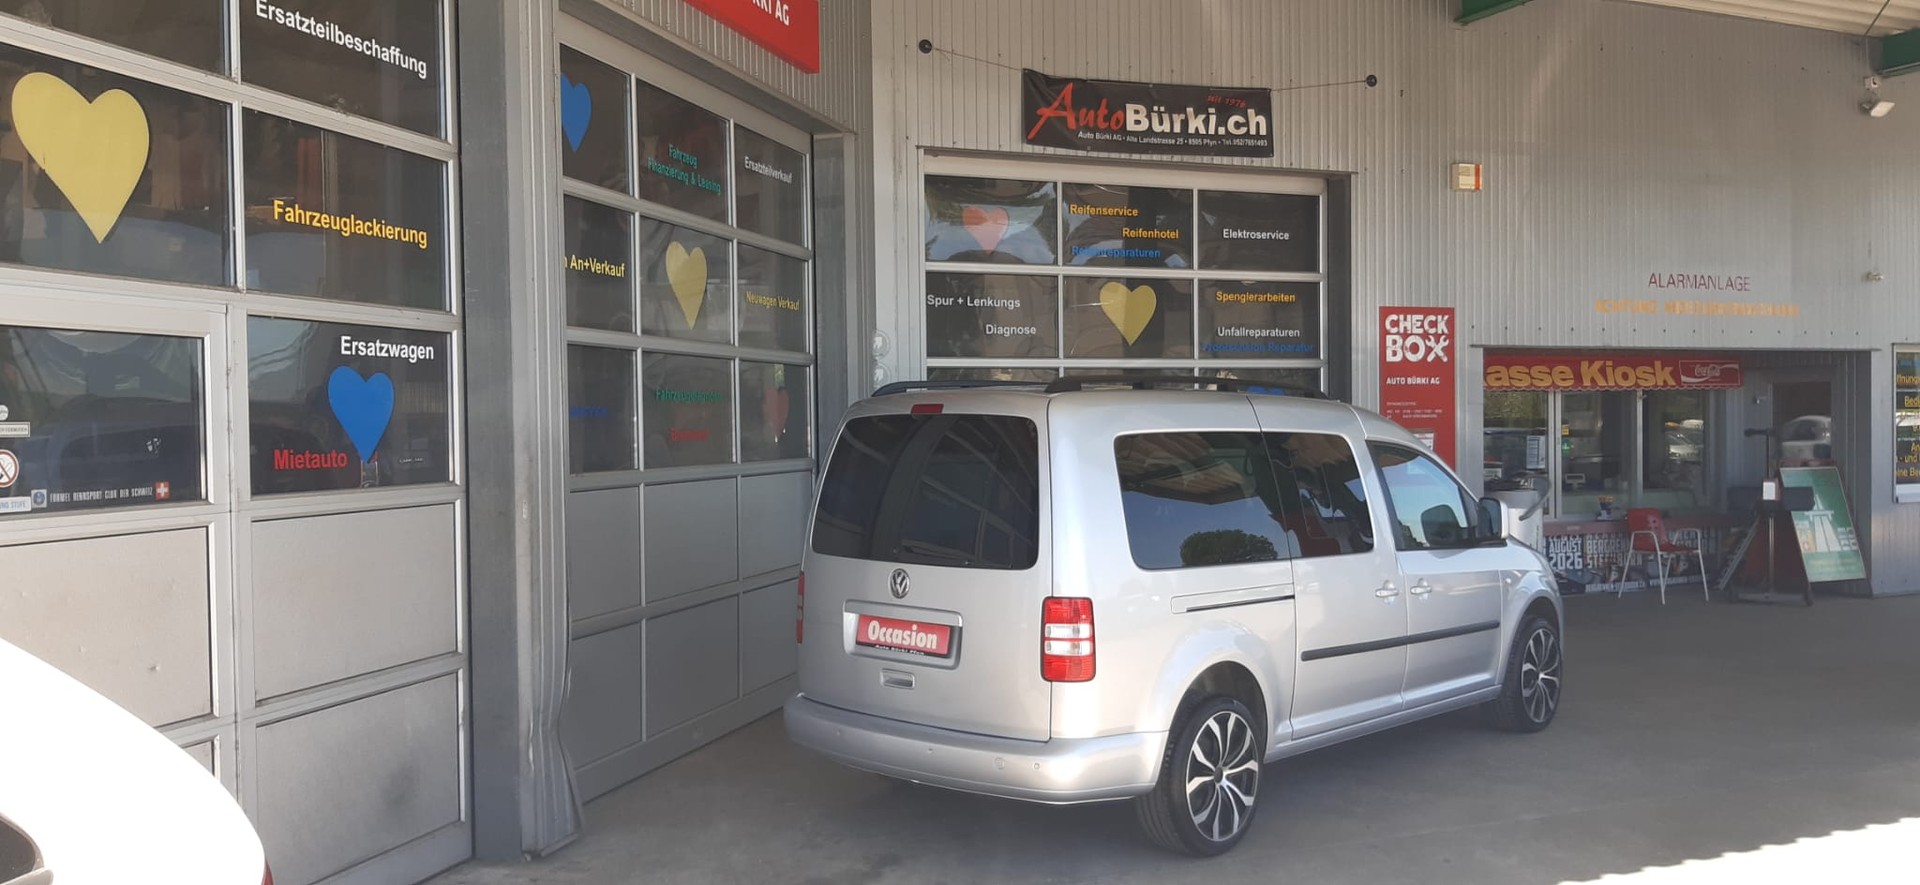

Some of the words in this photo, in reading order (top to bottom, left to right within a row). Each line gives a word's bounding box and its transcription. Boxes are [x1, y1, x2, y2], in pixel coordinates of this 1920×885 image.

[775, 0, 789, 26] AG
[256, 0, 427, 79] Ersatzteilbeschaffung
[1078, 131, 1094, 139] Auto
[669, 144, 698, 169] Fahrzeug
[647, 157, 689, 186] Finanzierung
[697, 174, 721, 196] Leasing
[744, 156, 793, 184] Ersatzteilverkauf
[1069, 204, 1139, 217] Reifenservice
[273, 200, 427, 249] Fahrzeuglackierung
[1122, 228, 1179, 240] Reifenhotel
[1223, 228, 1290, 241] Elektroservice
[1649, 272, 1751, 291] ALARMANLAGE
[746, 291, 777, 309] Neuwagen
[778, 295, 800, 311] Verkauf
[927, 295, 954, 309] Spur
[967, 295, 1021, 310] Lenkungs
[1216, 291, 1296, 305] Spenglerarbeiten
[985, 324, 1037, 337] Diagnose
[1217, 326, 1300, 339] Unfallreparaturen
[1385, 314, 1449, 334] CHECK
[340, 335, 434, 362] Ersatzwagen
[1407, 375, 1429, 384] BÜRKI
[1484, 364, 1574, 387] asse
[1580, 360, 1676, 387] Kiosk
[274, 449, 348, 470] Mietauto
[1550, 540, 1581, 553] AUGUST
[1549, 552, 1583, 570] 2026
[867, 620, 937, 650] Occasion
